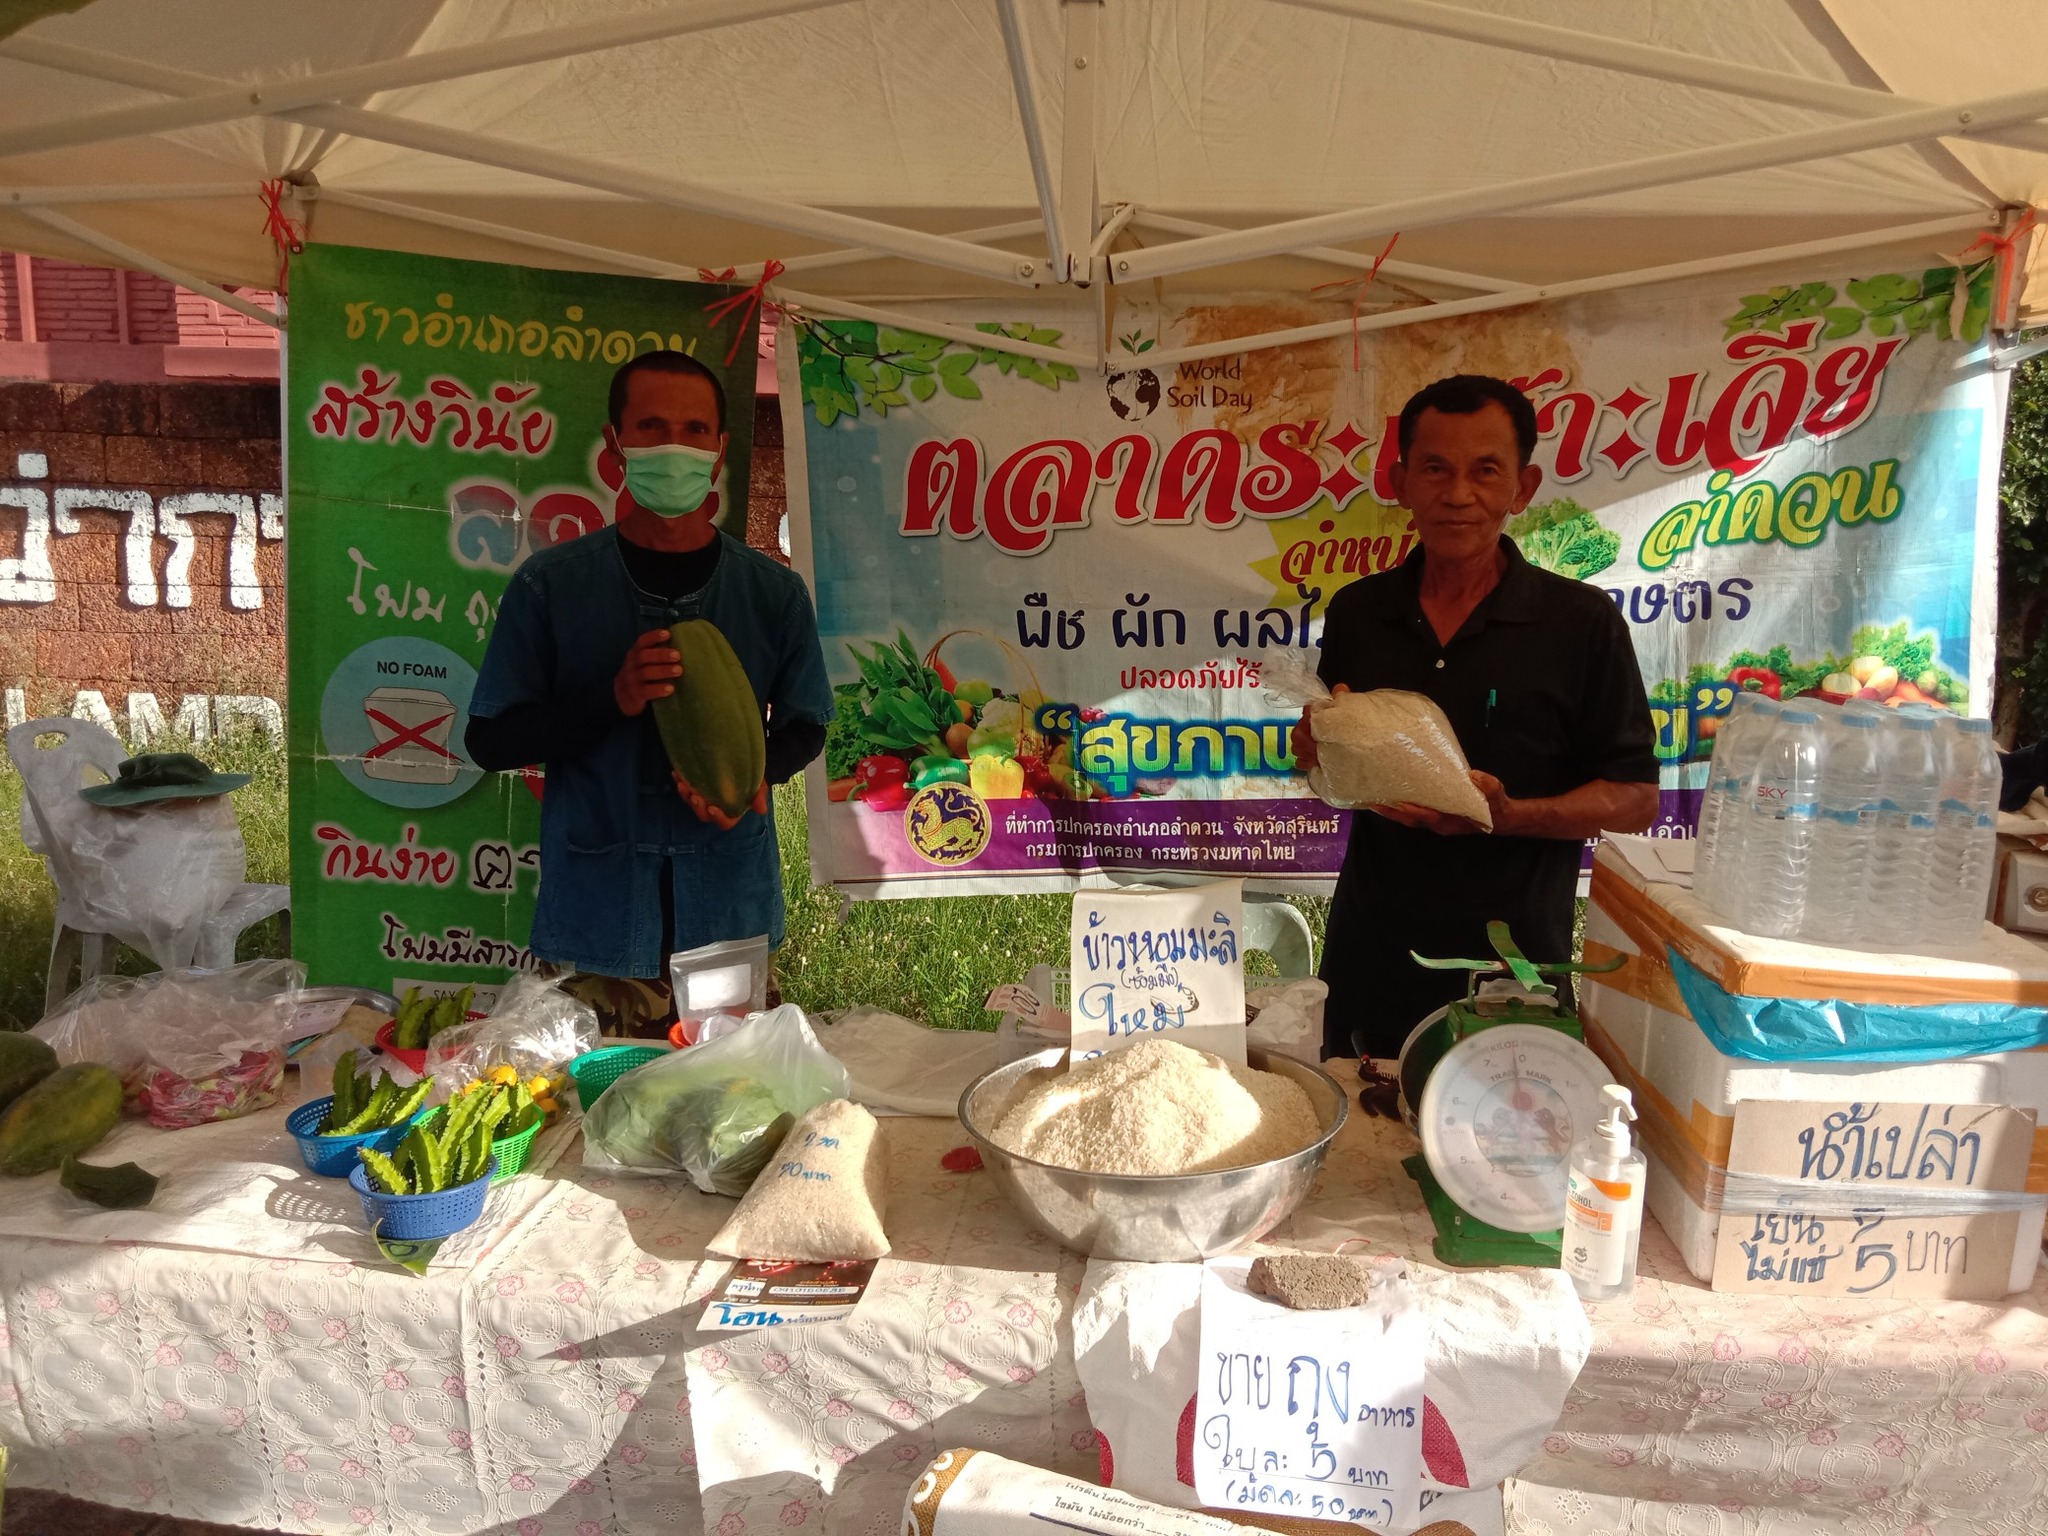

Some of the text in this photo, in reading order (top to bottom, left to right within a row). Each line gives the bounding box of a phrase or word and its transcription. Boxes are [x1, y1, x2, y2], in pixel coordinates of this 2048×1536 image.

[1180, 358, 1241, 380] World
[1167, 385, 1252, 414] Soil Day
[1640, 462, 1902, 571] ลำดวน
[1284, 519, 1418, 584] จำหน่
[347, 547, 447, 623] โฟม
[1016, 583, 1323, 650] พืช ผัก ผลไ
[377, 661, 447, 679] NO FOAM
[1757, 787, 1788, 799] SKY
[1005, 810, 1340, 839] ที่ทำการปกครองอำเภอลำดวน จังหวัดสุรินทร์
[1025, 839, 1296, 861] กรมการปกครอง กระทรวงมหาดไทย
[383, 914, 545, 970] โฟมมีสารก
[1082, 911, 1238, 971] ข้าวหอมมะลิ
[1797, 1101, 1982, 1186] น้ำเปล่า
[1846, 1244, 1898, 1294] 5
[1906, 1229, 1970, 1276] บาท
[1216, 1352, 1271, 1410] ขาย
[1356, 1403, 1416, 1429] อาหาร
[1347, 1466, 1388, 1486] บาท
[1088, 1505, 1145, 1529] ไม่น้อยกว่า
